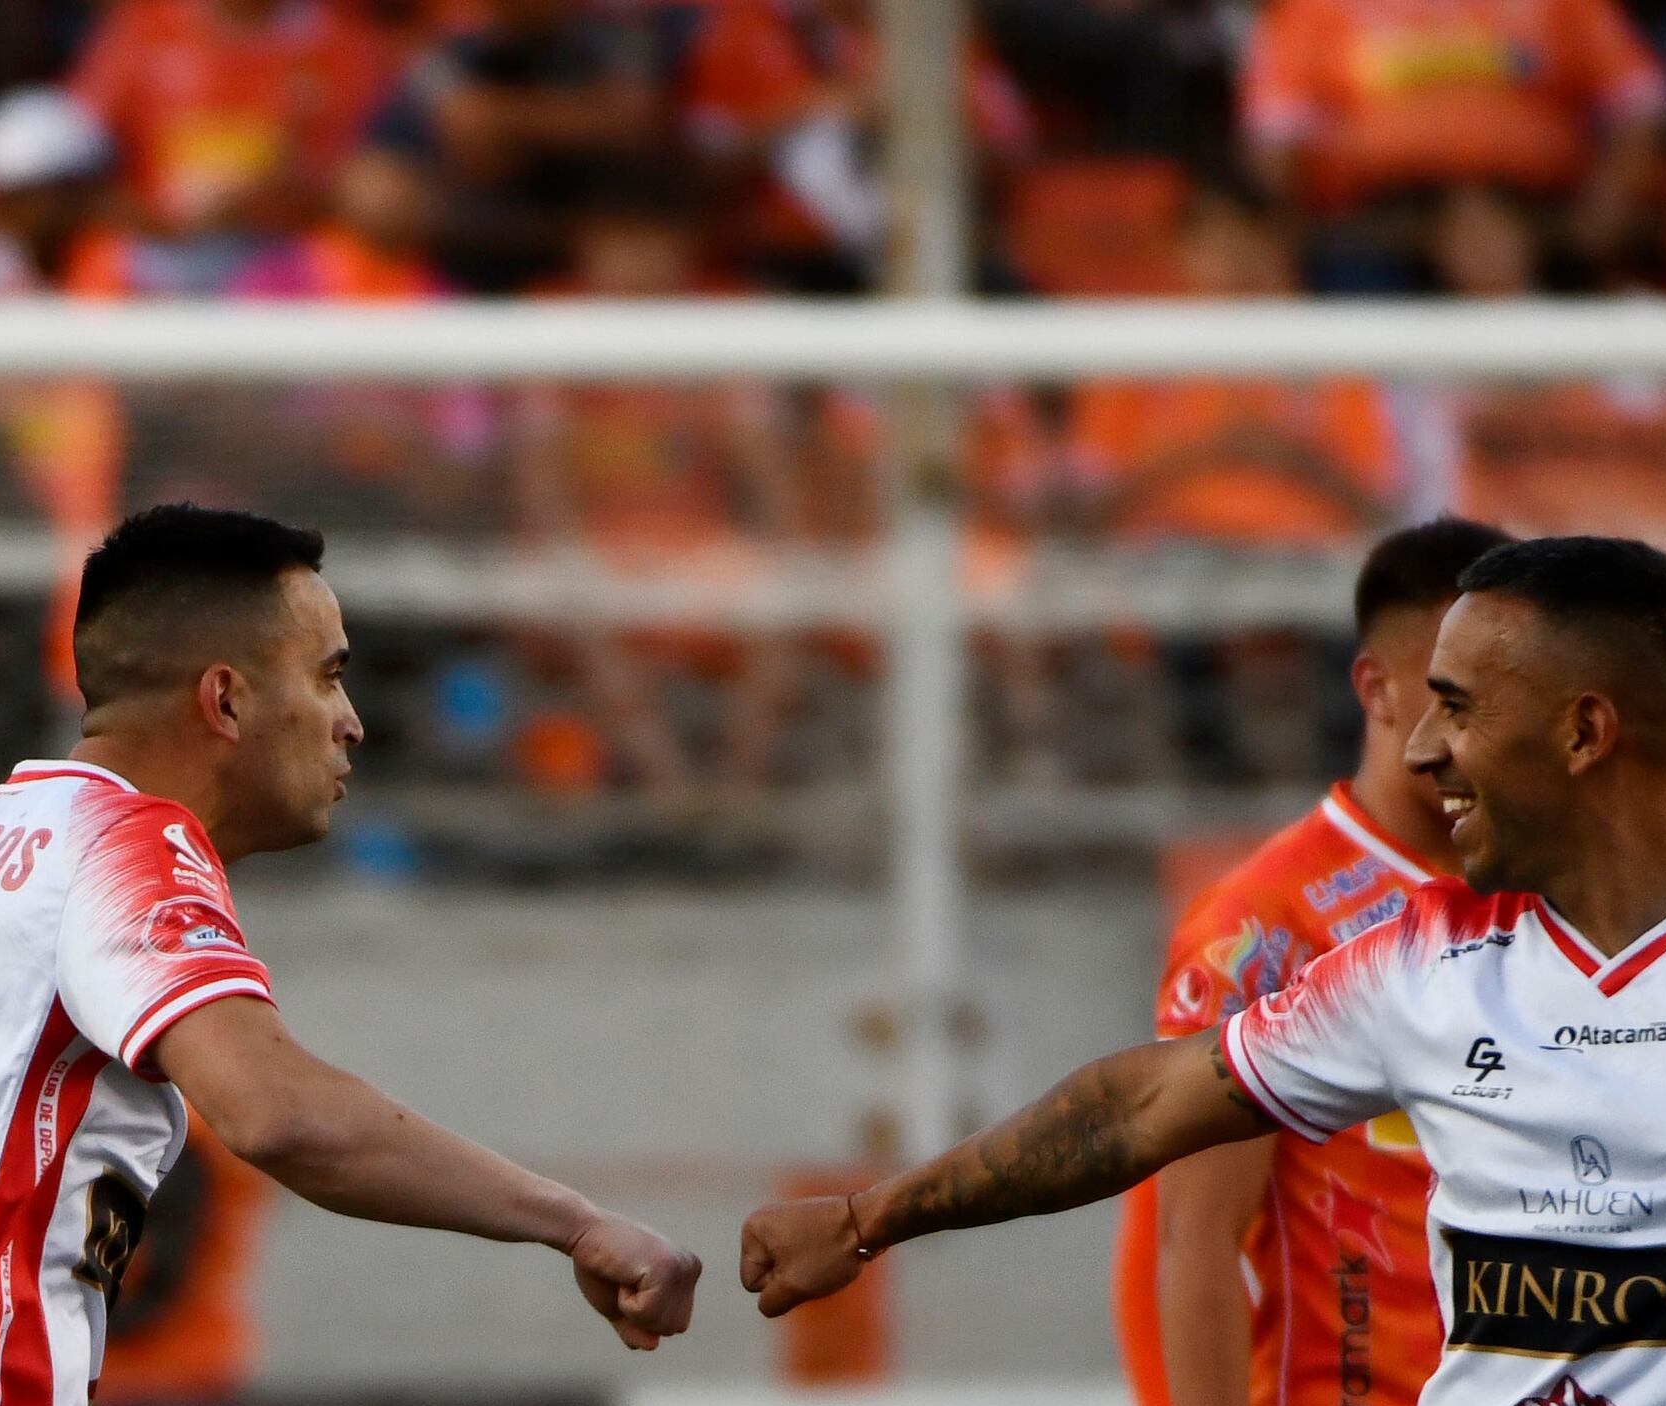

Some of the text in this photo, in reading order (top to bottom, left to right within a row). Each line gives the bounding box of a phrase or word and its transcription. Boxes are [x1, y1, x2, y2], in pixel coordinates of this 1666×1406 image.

[43, 1060, 69, 1098] CLUB
[38, 1102, 53, 1123] DE
[1518, 1188, 1654, 1216] LAHUEN
